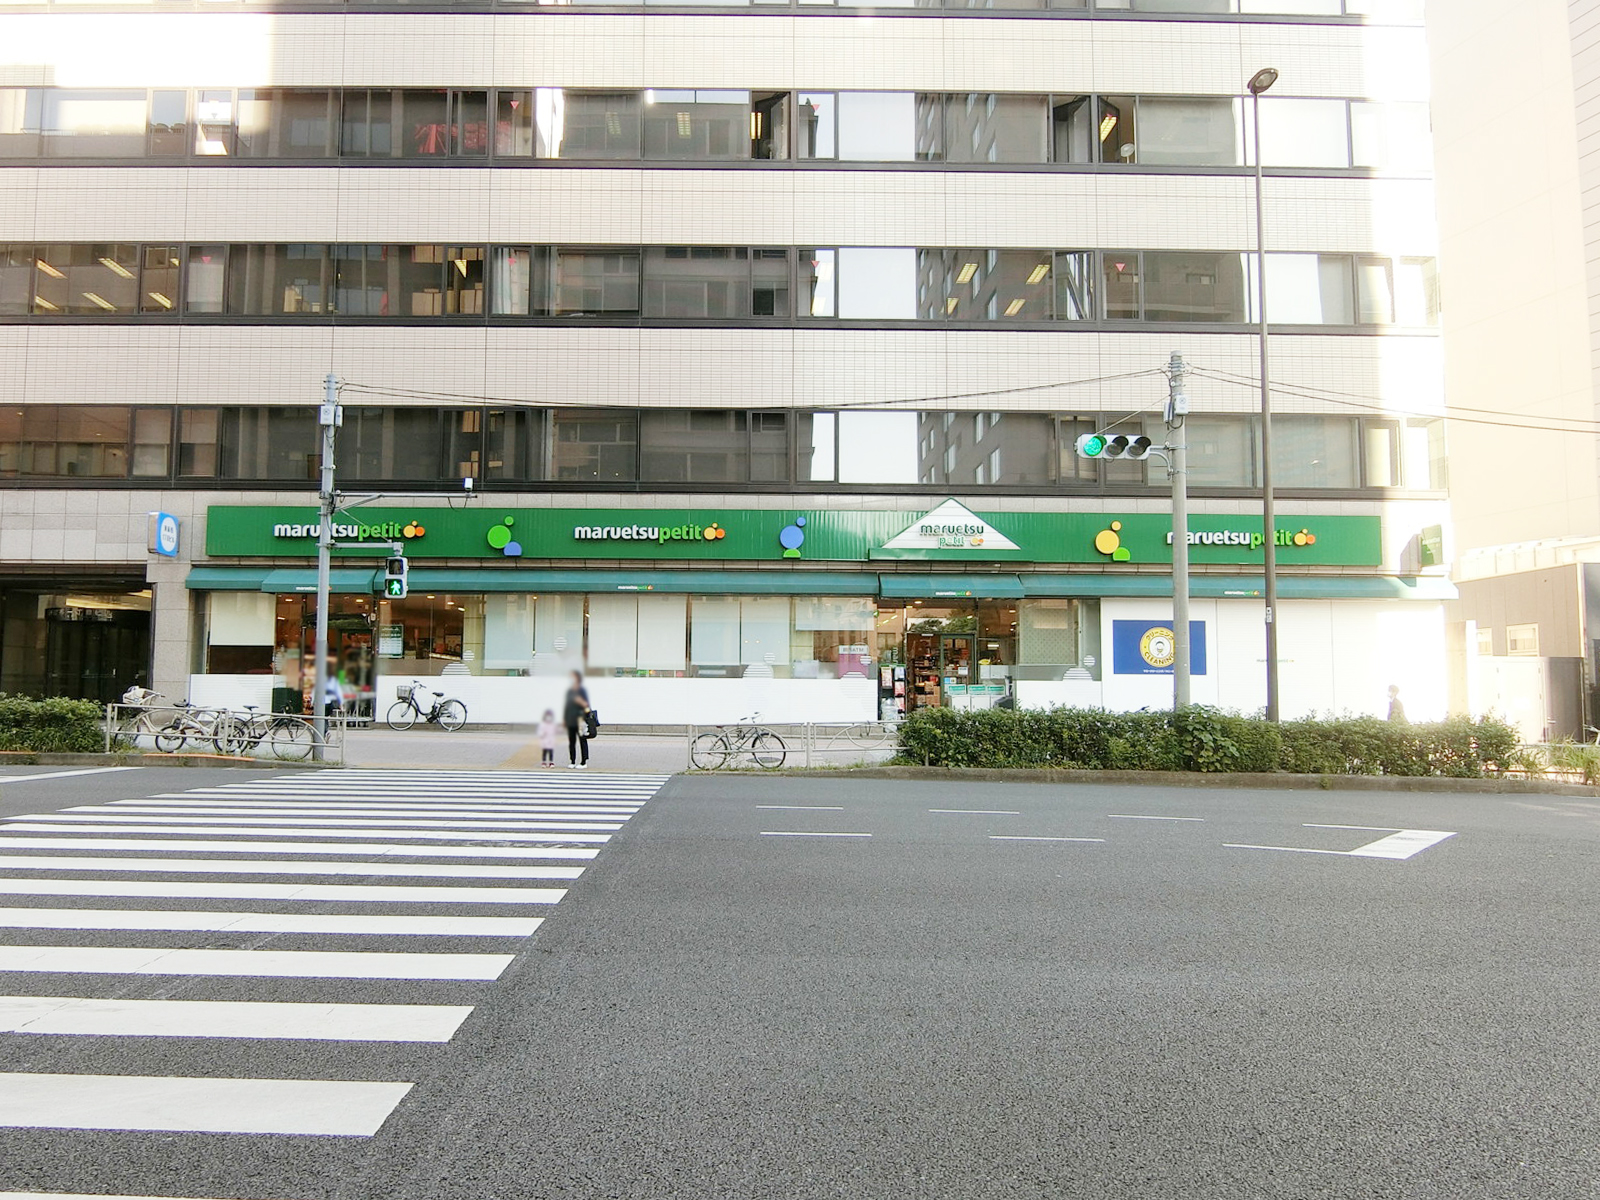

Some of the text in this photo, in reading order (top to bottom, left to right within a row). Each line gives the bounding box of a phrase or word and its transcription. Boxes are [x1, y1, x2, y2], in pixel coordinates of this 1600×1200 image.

[274, 522, 401, 541] marutsupetit
[920, 524, 984, 534] maruetsu
[939, 536, 965, 546] petit
